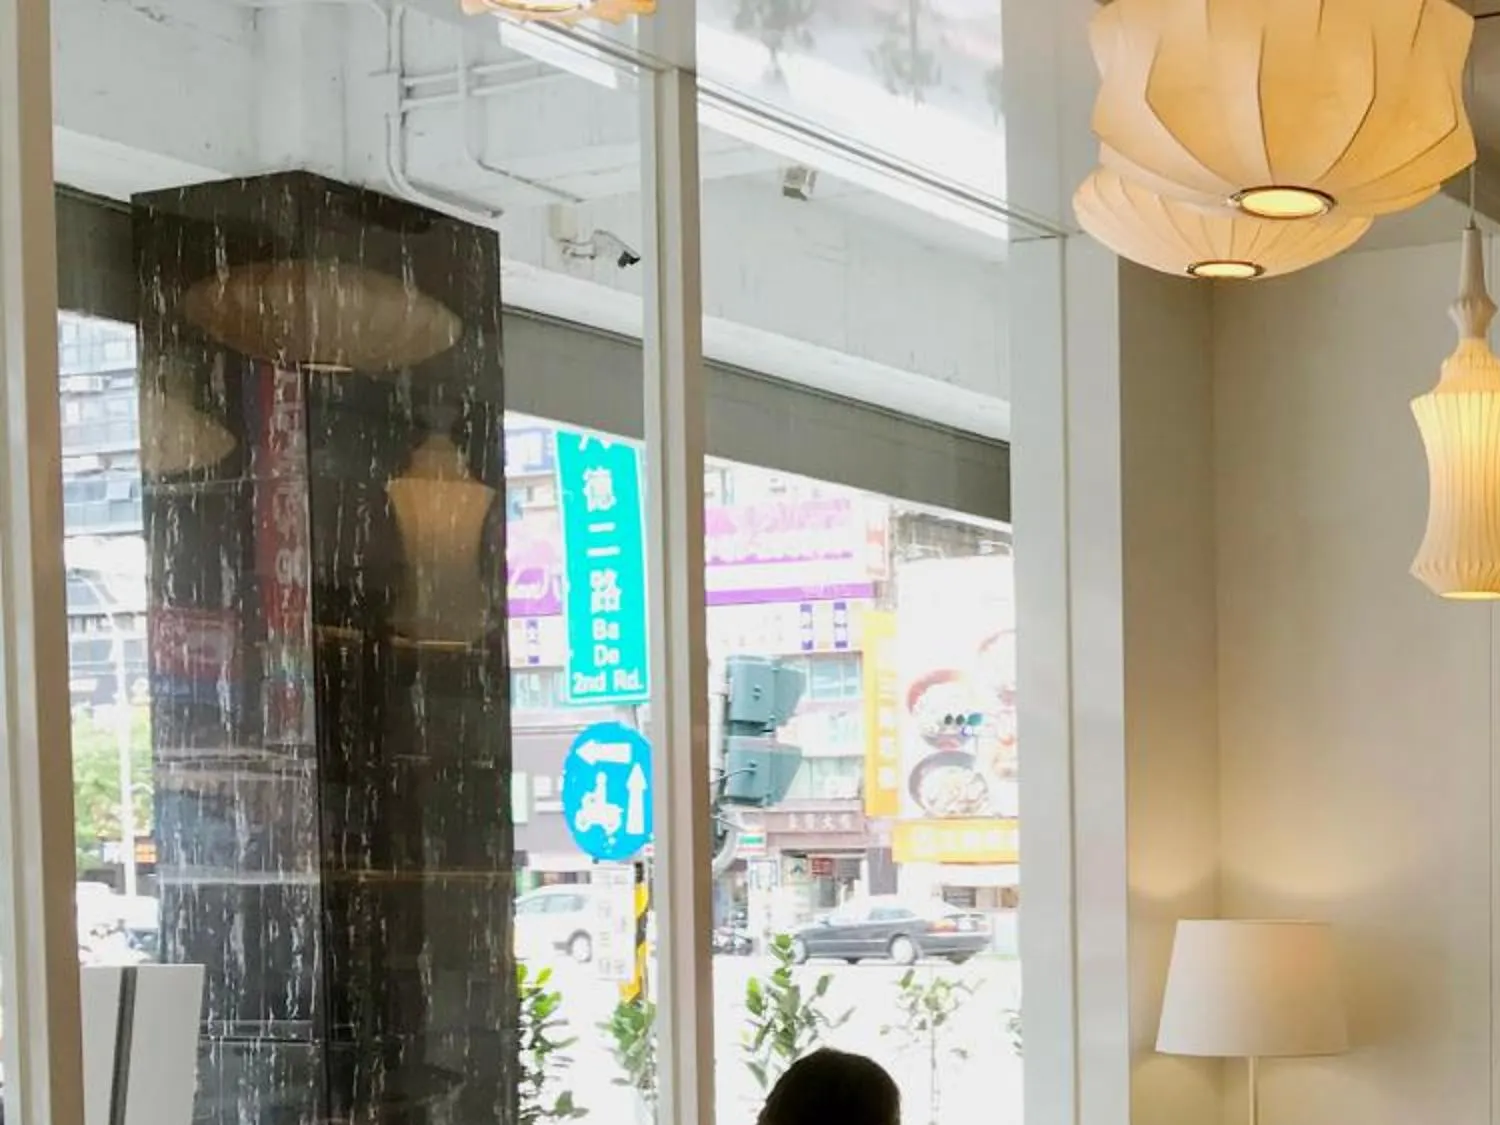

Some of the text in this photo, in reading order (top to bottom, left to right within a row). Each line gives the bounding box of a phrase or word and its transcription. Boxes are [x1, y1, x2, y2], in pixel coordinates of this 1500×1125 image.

[591, 617, 621, 641] Ba
[572, 667, 644, 694] 2nd Rd.
